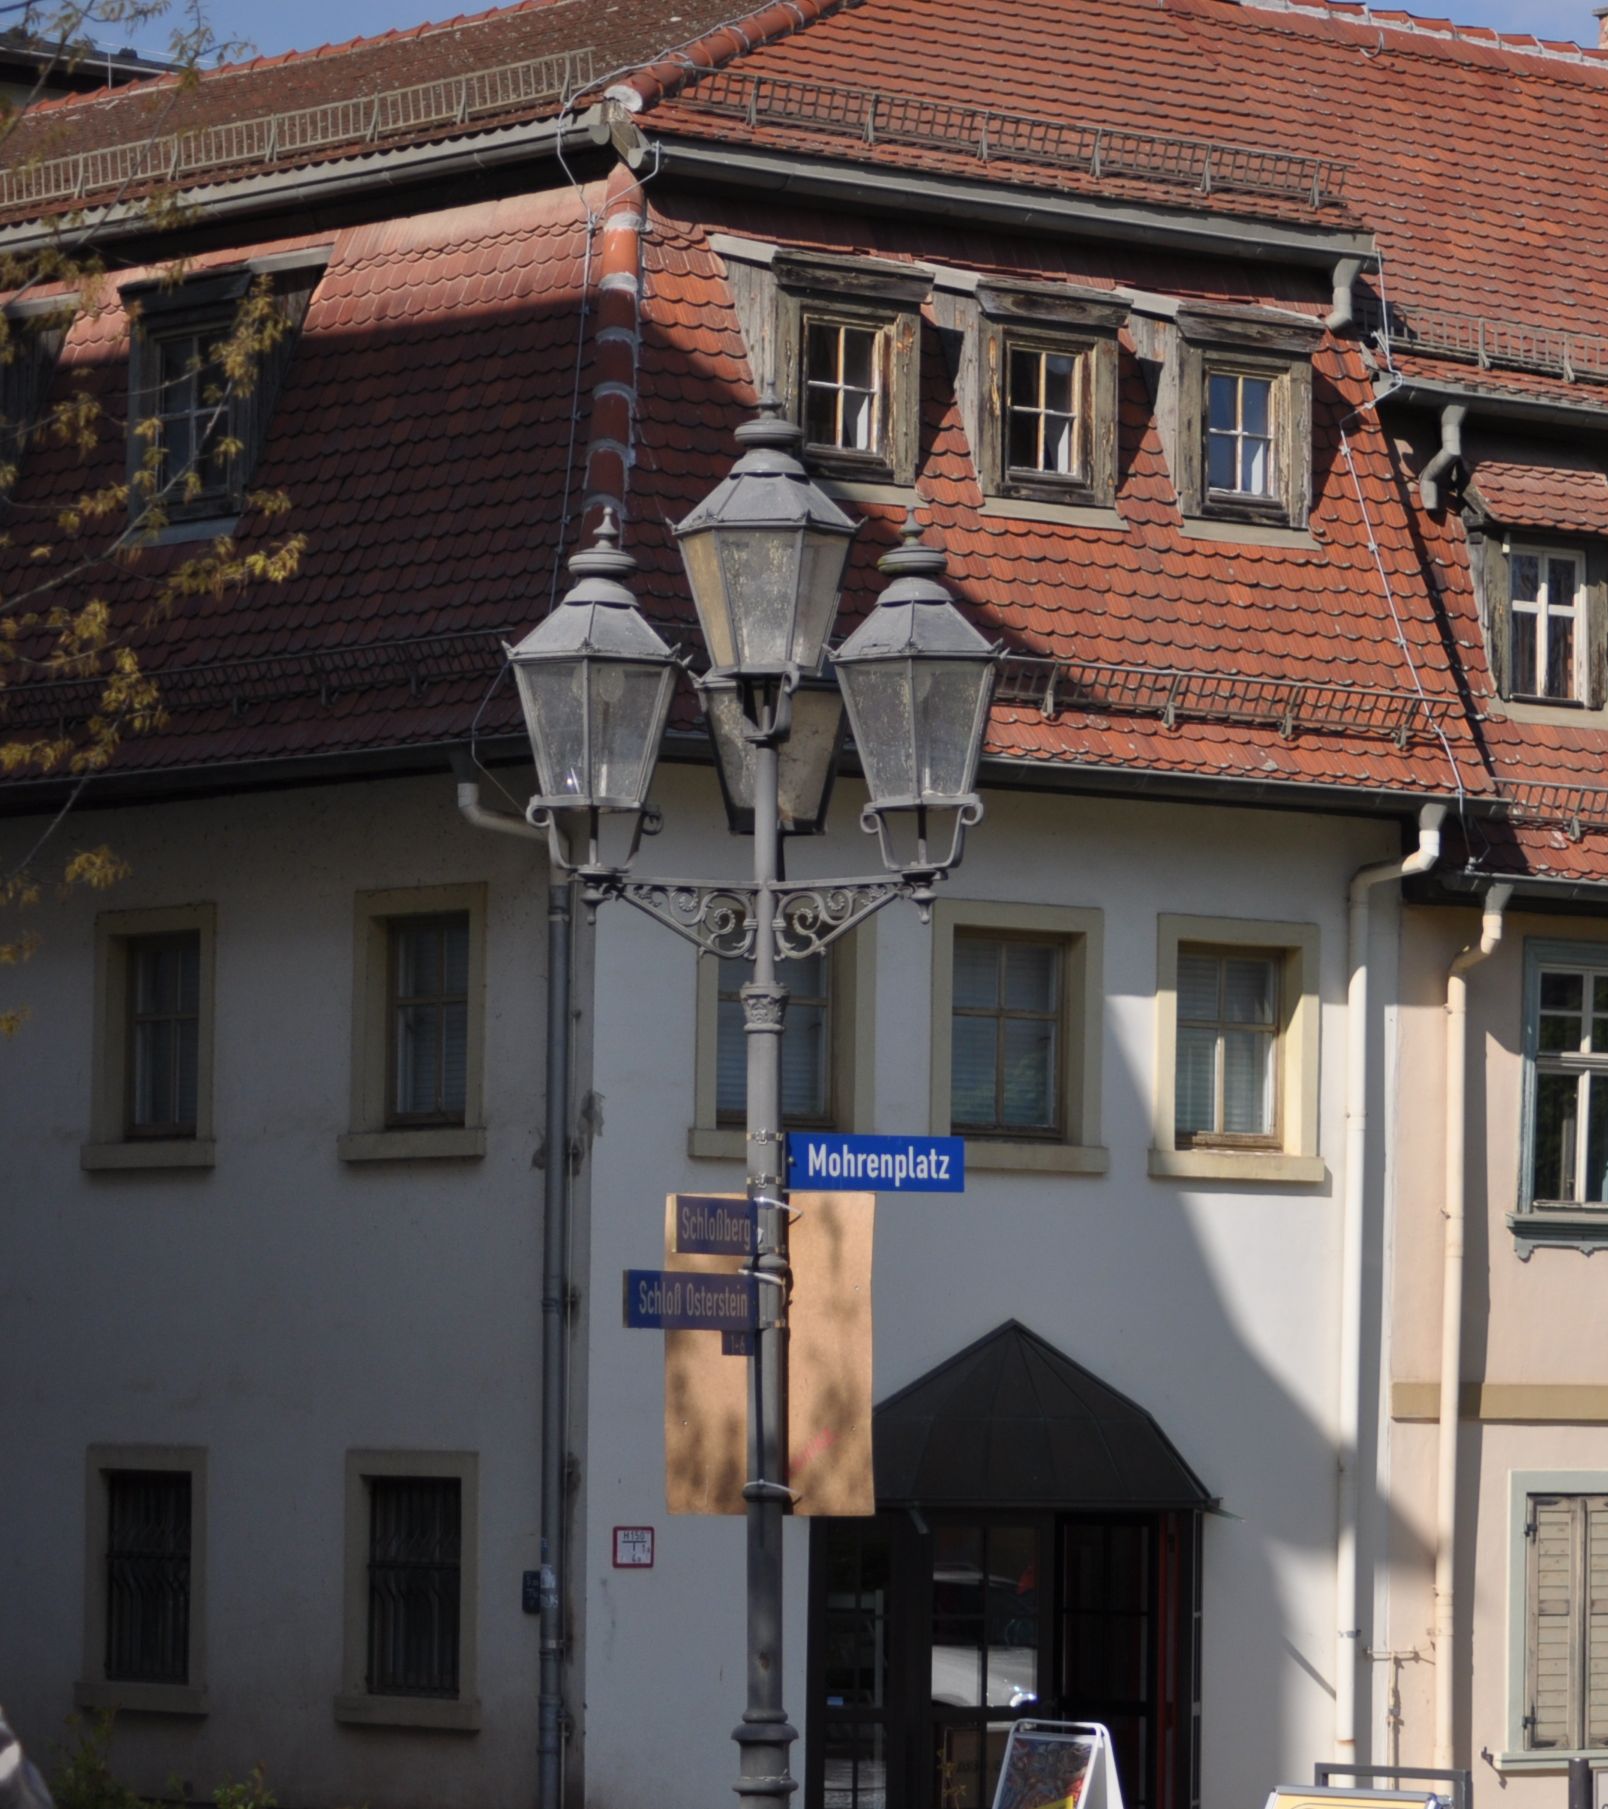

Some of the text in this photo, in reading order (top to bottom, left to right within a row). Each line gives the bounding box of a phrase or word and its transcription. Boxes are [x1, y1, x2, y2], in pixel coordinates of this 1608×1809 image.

[808, 1143, 950, 1187] Mohrenplatz
[682, 1206, 751, 1251] Schloßberg
[639, 1280, 749, 1318] Schloß Osterstein
